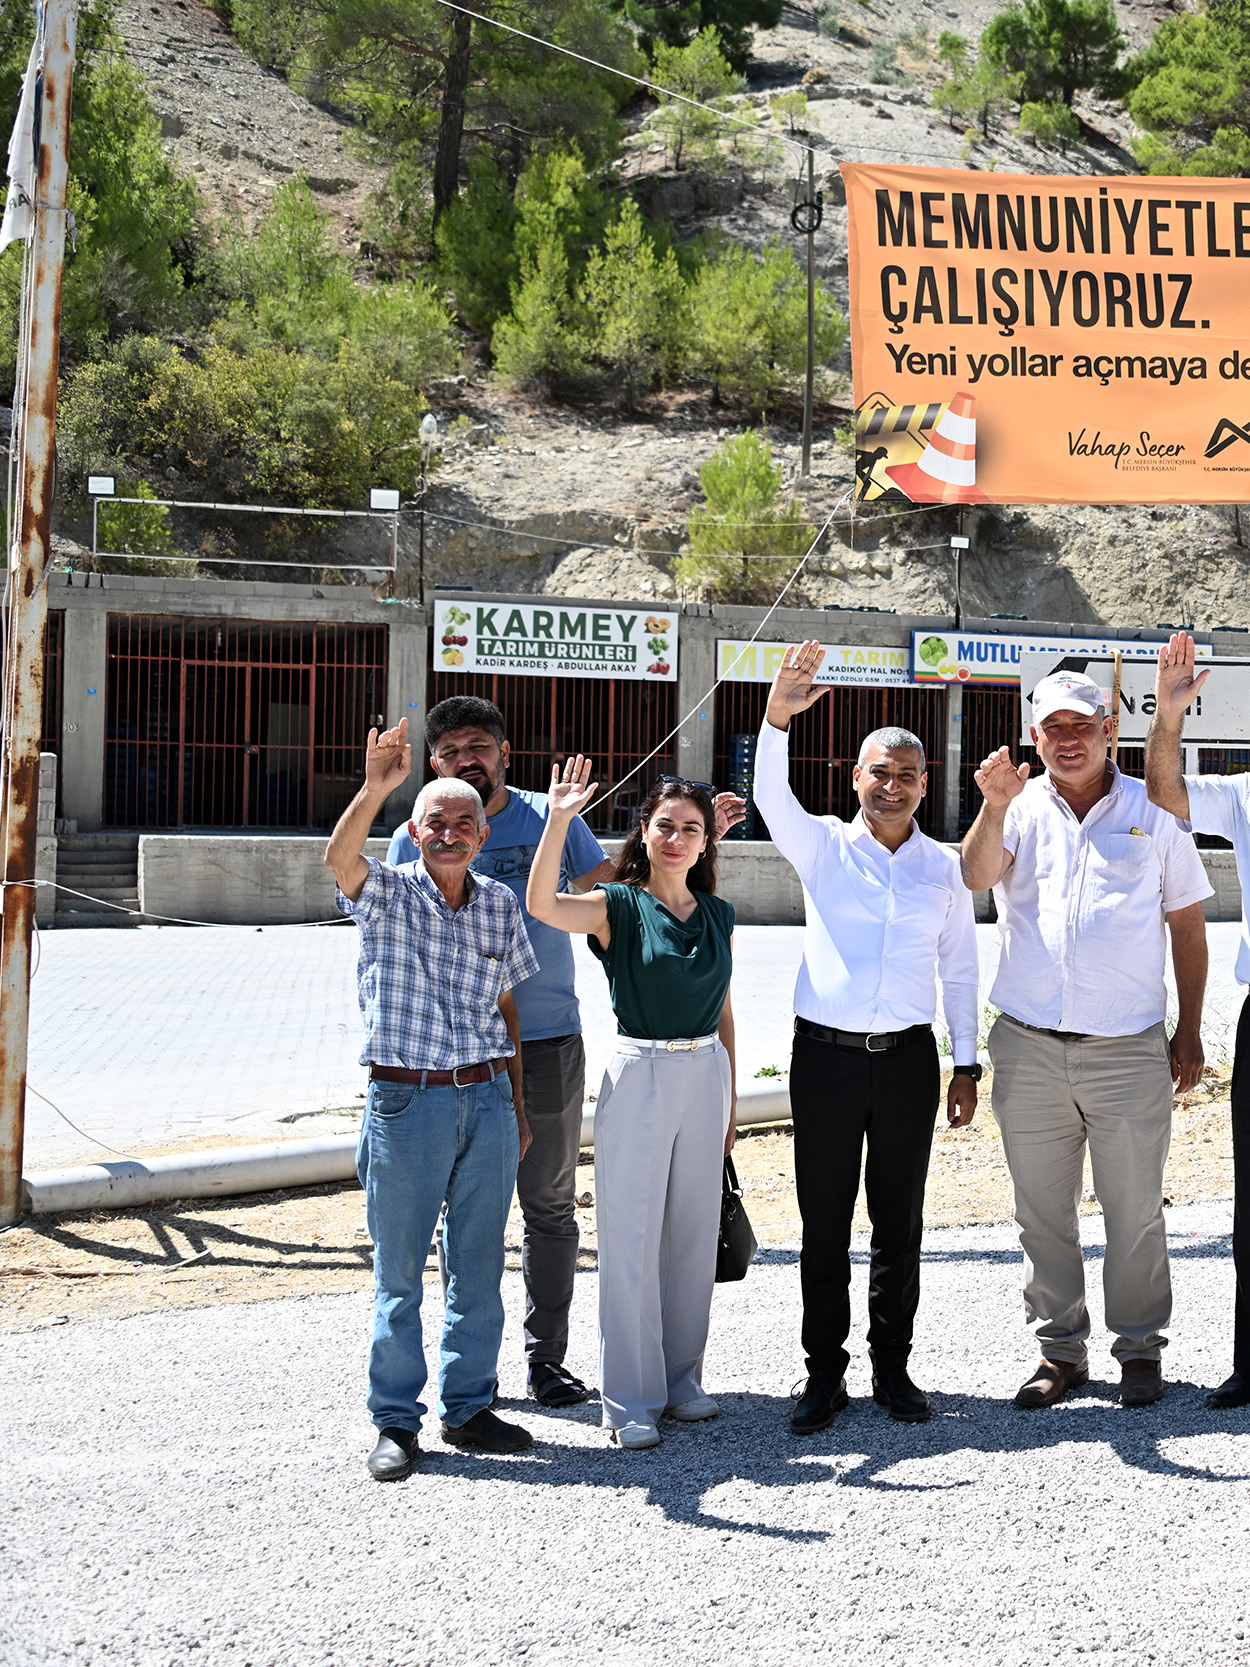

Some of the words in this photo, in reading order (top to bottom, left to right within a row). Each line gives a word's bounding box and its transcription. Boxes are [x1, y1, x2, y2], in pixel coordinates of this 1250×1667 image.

[880, 265, 1210, 337] ÇALIŞIYORUZ.
[885, 343, 957, 376] Yeni
[966, 346, 1064, 383] yollar
[1072, 354, 1207, 386] açmaya
[1068, 428, 1131, 469] Vahap
[1136, 431, 1185, 458] Seçer
[475, 607, 638, 642] KARMEY
[481, 640, 539, 657] TARIM
[840, 650, 905, 667] TARIM
[957, 640, 1022, 664] MUTLU
[509, 659, 548, 671] KARDEŞ
[557, 662, 608, 672] ABDULLAH
[611, 663, 637, 673] AKAY
[828, 665, 868, 674] KADIKÖY
[870, 667, 887, 675] HAL
